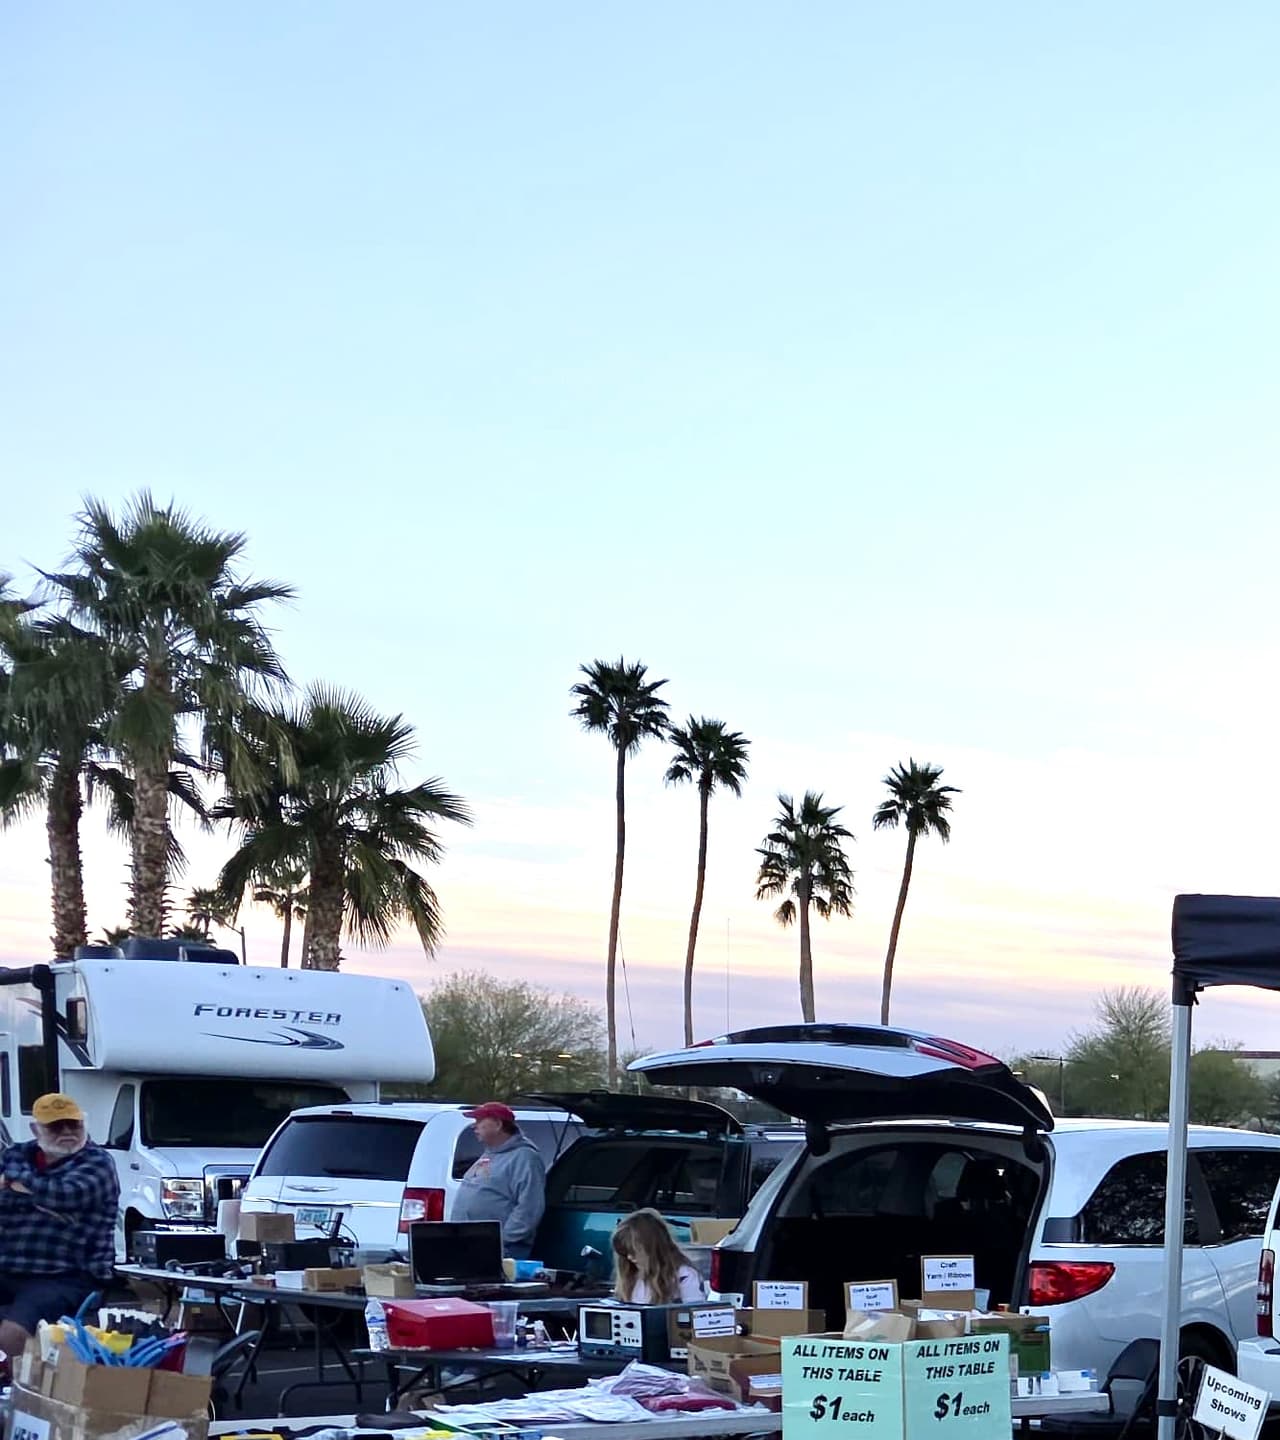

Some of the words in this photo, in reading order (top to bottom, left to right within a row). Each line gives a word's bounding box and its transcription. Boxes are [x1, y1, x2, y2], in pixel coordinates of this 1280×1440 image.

[193, 1003, 341, 1023] FORESTER
[793, 1344, 817, 1357] ALL
[822, 1346, 864, 1360] ITEMS
[868, 1348, 889, 1361] ON
[916, 1344, 940, 1359] ALL
[943, 1342, 980, 1357] ITEMS
[983, 1340, 1000, 1352] ON
[802, 1366, 833, 1380] THIS
[838, 1368, 882, 1383] TABLE
[925, 1364, 956, 1380] THIS
[958, 1361, 995, 1376] TABLE
[1207, 1375, 1261, 1410] Upcoming
[809, 1394, 843, 1422] $1
[842, 1410, 875, 1423] each
[933, 1391, 963, 1422] $1
[962, 1401, 990, 1416] each
[1210, 1398, 1247, 1422] Shows
